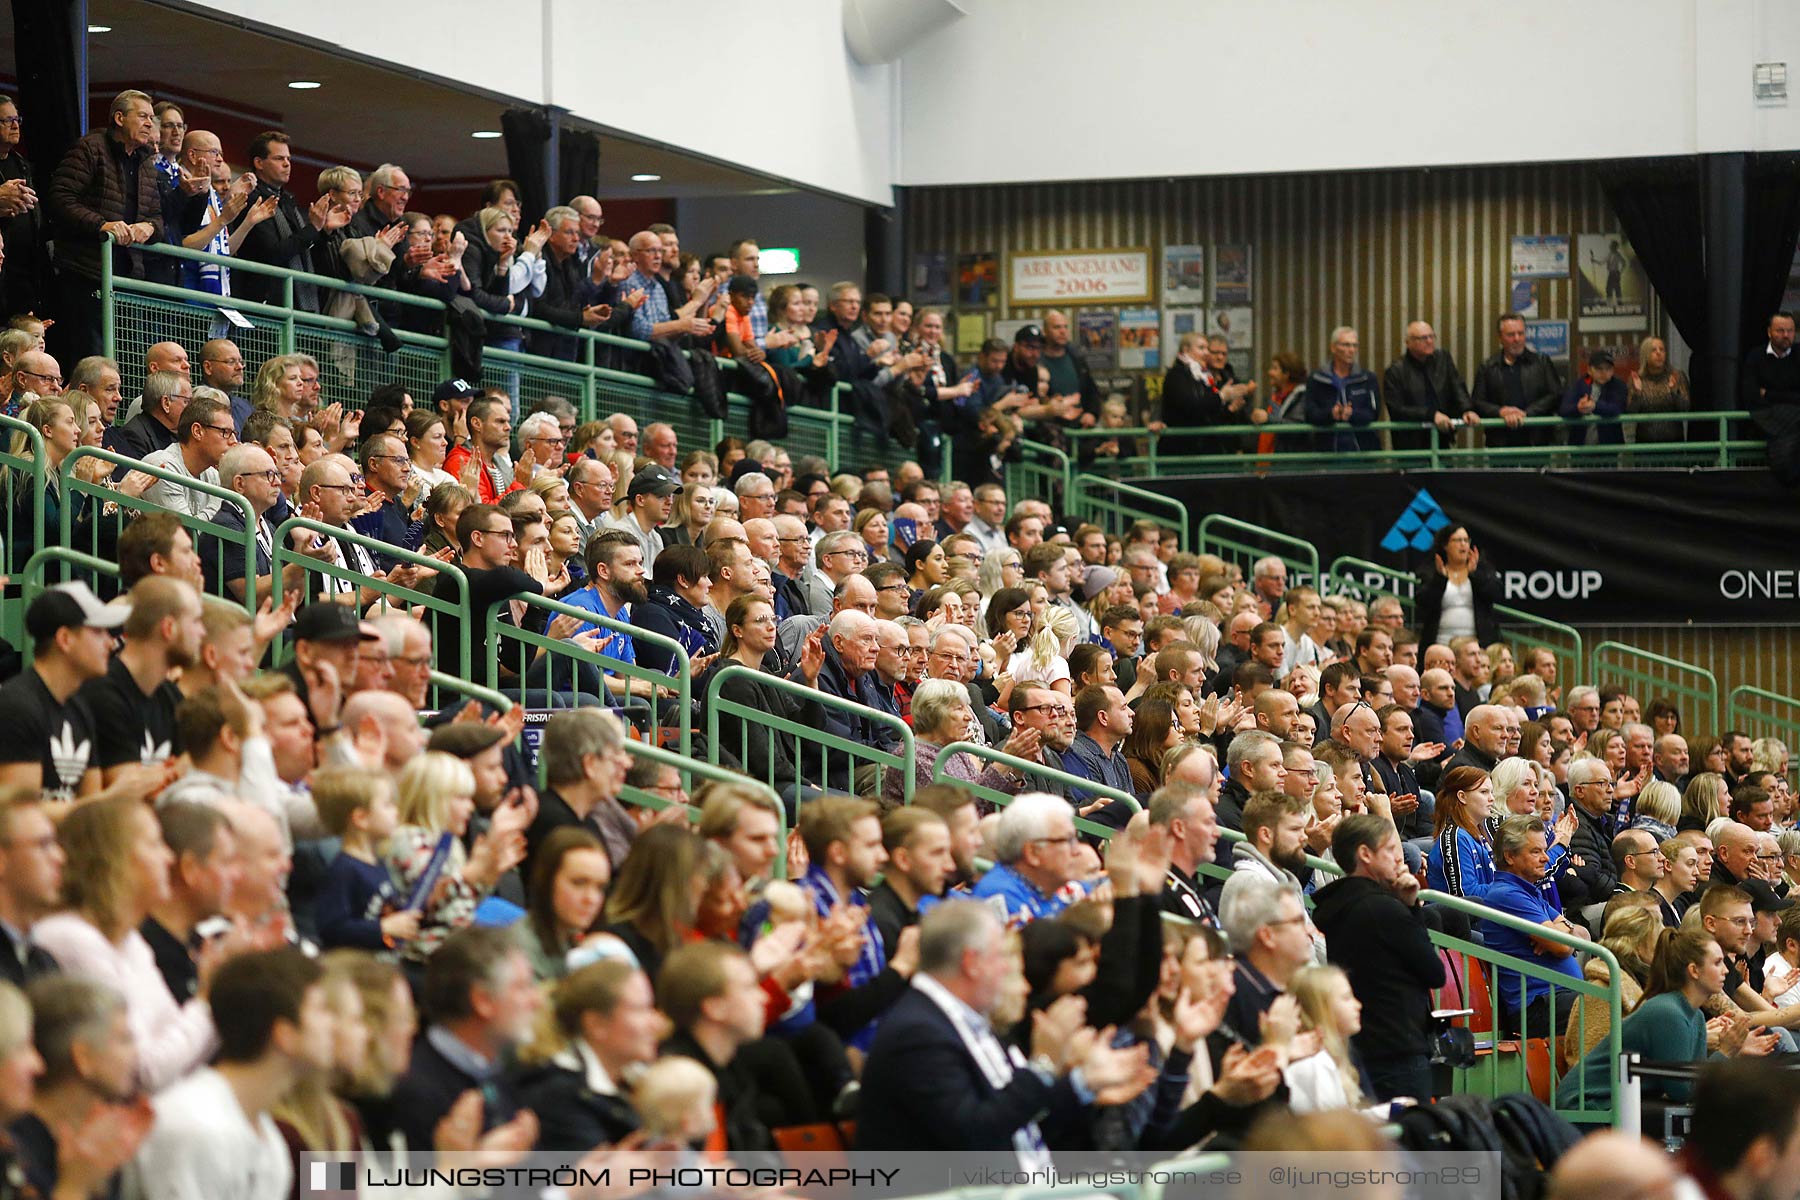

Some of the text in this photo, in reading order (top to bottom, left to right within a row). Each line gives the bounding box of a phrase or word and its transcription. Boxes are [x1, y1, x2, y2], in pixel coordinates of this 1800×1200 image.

[1023, 258, 1140, 276] ARRANGEMANG
[1055, 278, 1108, 295] 2006
[1719, 569, 1800, 599] ONE
[522, 713, 554, 723] FRISTAD
